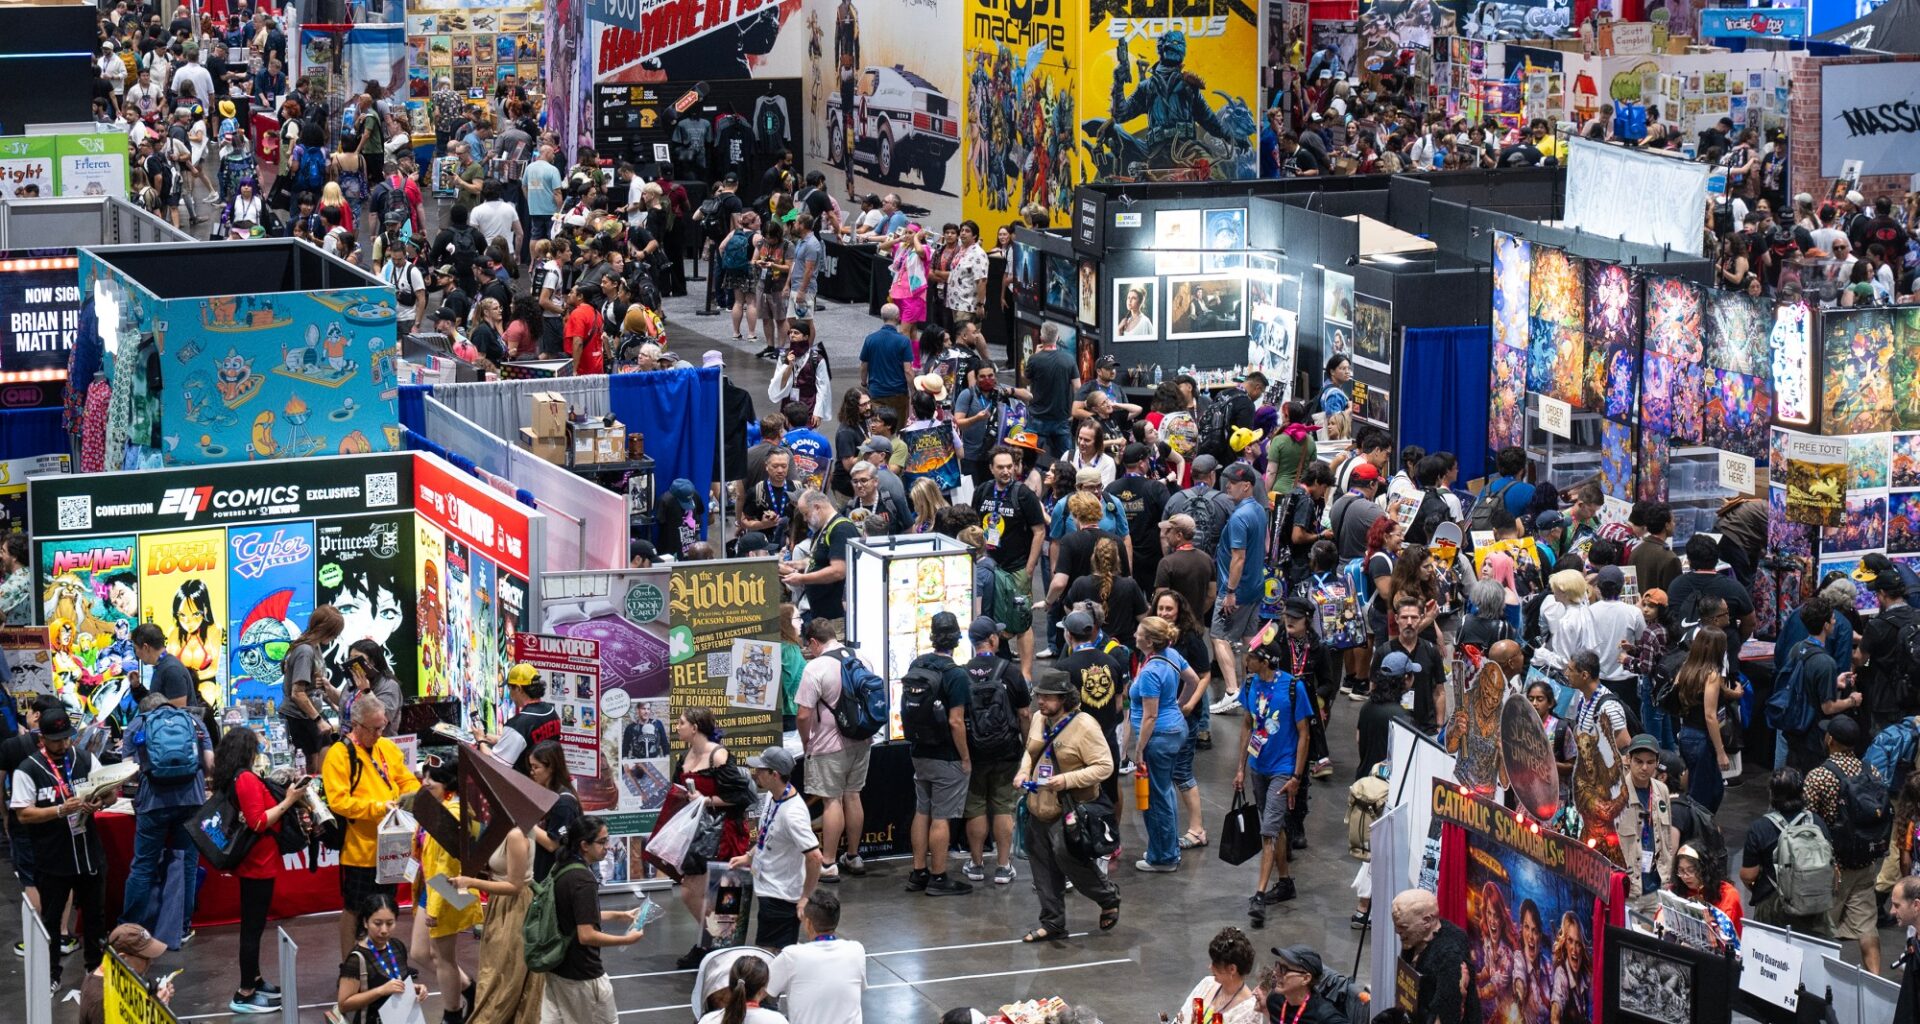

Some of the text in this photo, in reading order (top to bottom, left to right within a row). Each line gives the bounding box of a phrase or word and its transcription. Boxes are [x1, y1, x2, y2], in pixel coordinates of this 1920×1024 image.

[1108, 16, 1228, 41] EXODUS
[1621, 27, 1643, 36] Scott
[1615, 36, 1649, 46] Campbell
[1083, 228, 1093, 240] ART
[25, 287, 53, 304] NOW
[11, 311, 59, 333] BRIAN
[16, 331, 59, 352] MATT
[1545, 404, 1564, 419] ORDER
[1547, 415, 1561, 428] HERE
[1793, 442, 1816, 452] FREE
[1818, 443, 1842, 455] TOTE
[1726, 459, 1747, 474] ORDER
[1728, 470, 1744, 484] HERE
[306, 486, 360, 501] EXCLUSIVES
[95, 502, 154, 517] CONVENTION
[157, 485, 300, 521] 247 COMICS
[213, 510, 246, 518] POWERED
[320, 534, 378, 556] Princess
[421, 529, 442, 556] Domo
[700, 571, 712, 581] the
[670, 571, 767, 612] Hobbit
[693, 614, 762, 627] JACKSON ROBINSON
[693, 625, 763, 644] COMING TO KICKSTARTER
[537, 637, 596, 657] TOKYOPOP
[561, 661, 597, 674] EXCLUSIVES
[669, 661, 708, 687] REE
[672, 687, 725, 696] COMICON EXCLUSIVE
[670, 695, 683, 707] OM
[711, 706, 727, 716] RINT
[714, 717, 736, 728] CKSON
[738, 714, 771, 725] ROBINSON
[564, 735, 597, 745] SIGNINGS
[671, 735, 774, 750] HOW OUR FREE PRINT!
[1433, 785, 1490, 834] CATHOLIC
[1495, 810, 1557, 867] SCHOOLGIRLS
[1564, 849, 1610, 890] INBREEDS
[379, 853, 399, 863] HANK
[1752, 948, 1790, 972] Tony Guaraldi-
[1760, 966, 1777, 981] Brown
